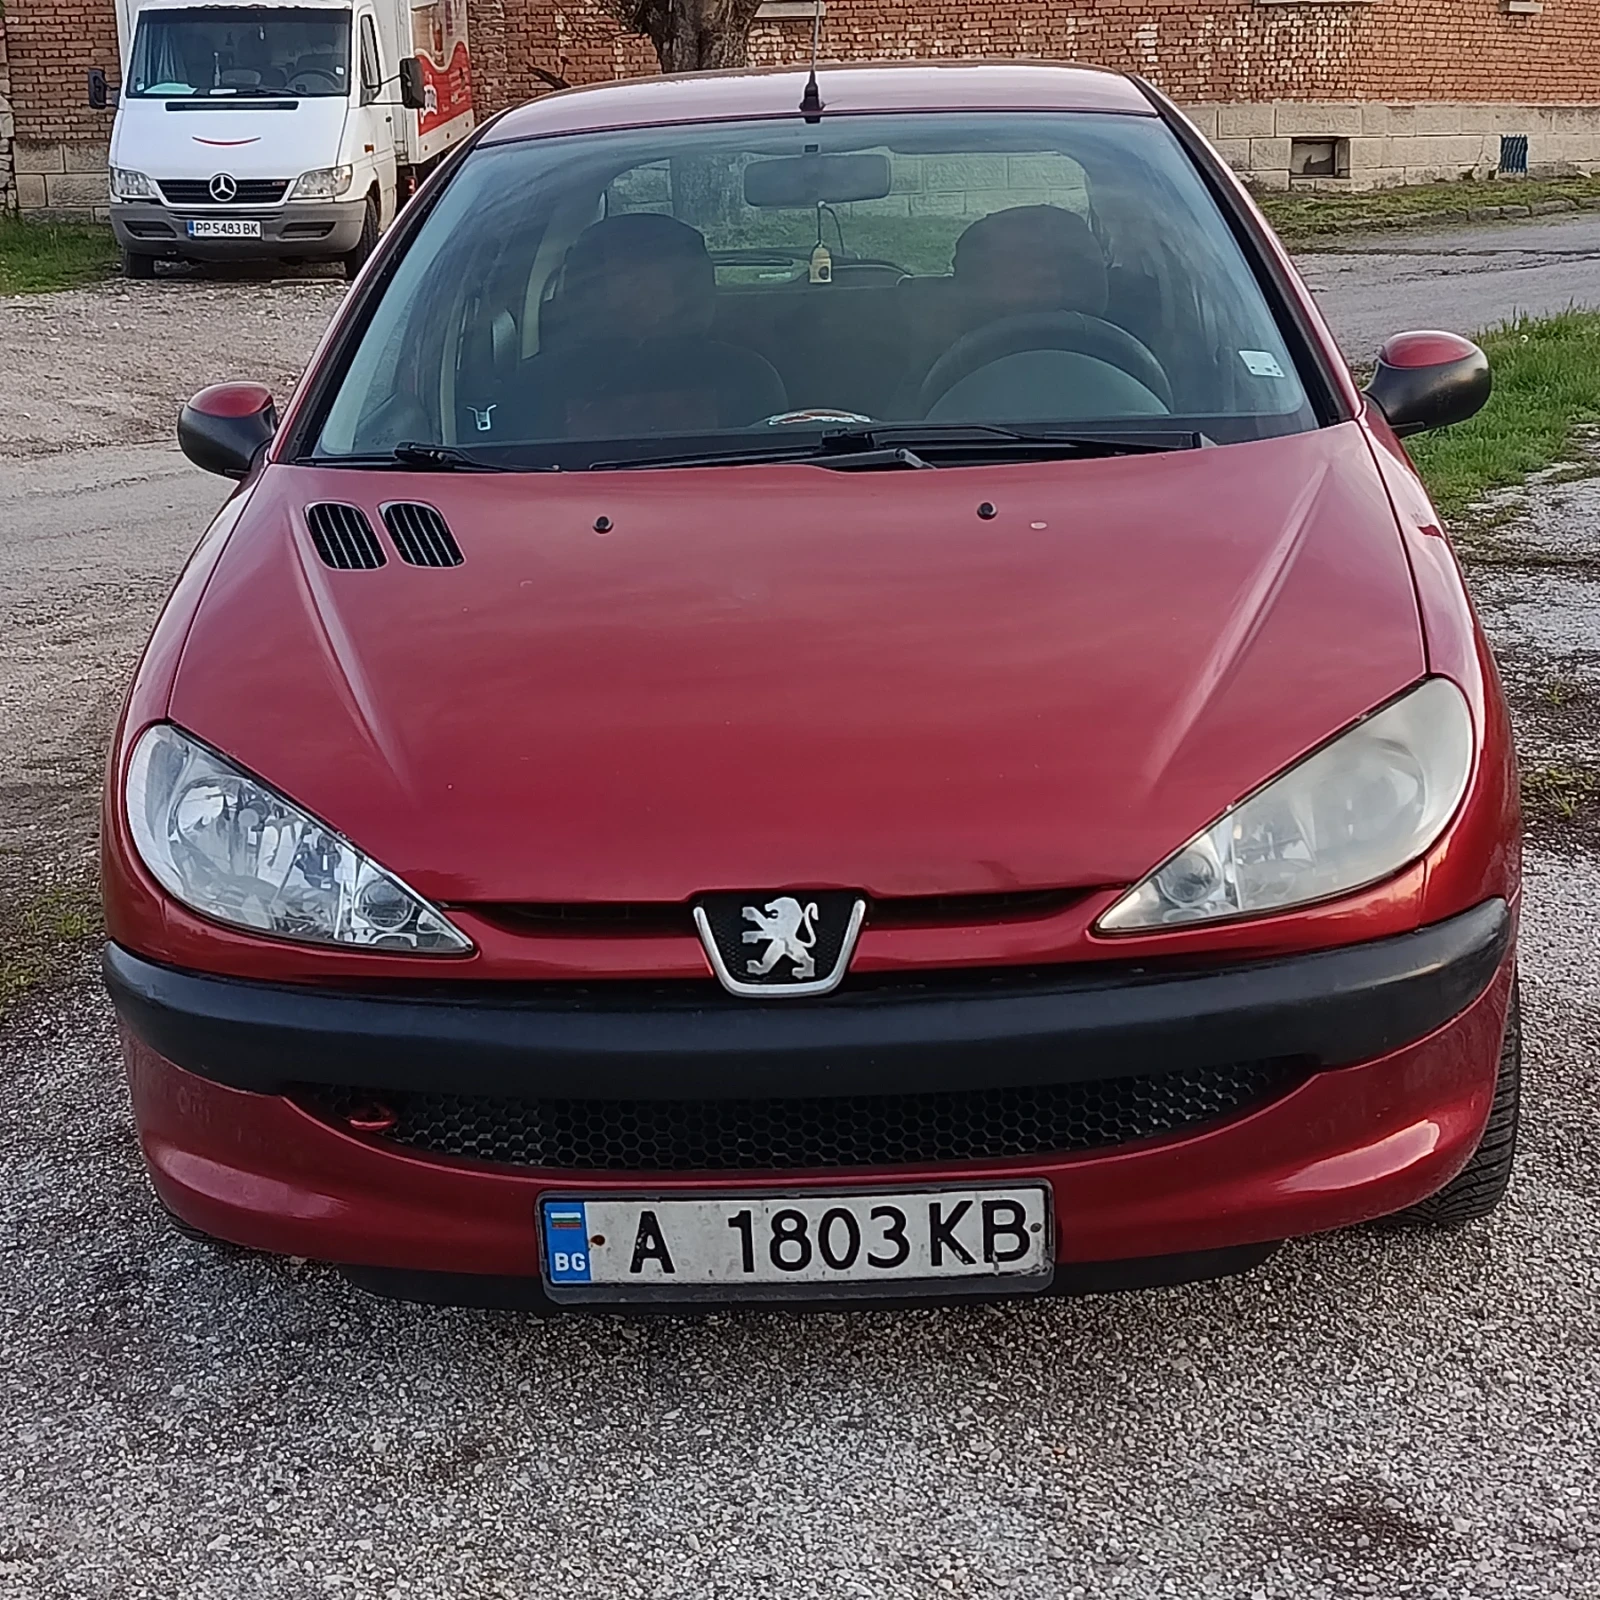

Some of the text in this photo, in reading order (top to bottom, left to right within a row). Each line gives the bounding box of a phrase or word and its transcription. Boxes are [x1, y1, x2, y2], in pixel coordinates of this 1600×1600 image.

[196, 222, 258, 235] PP 5483 BK
[629, 1199, 1032, 1274] A 1803 KB
[554, 1252, 586, 1271] BG
